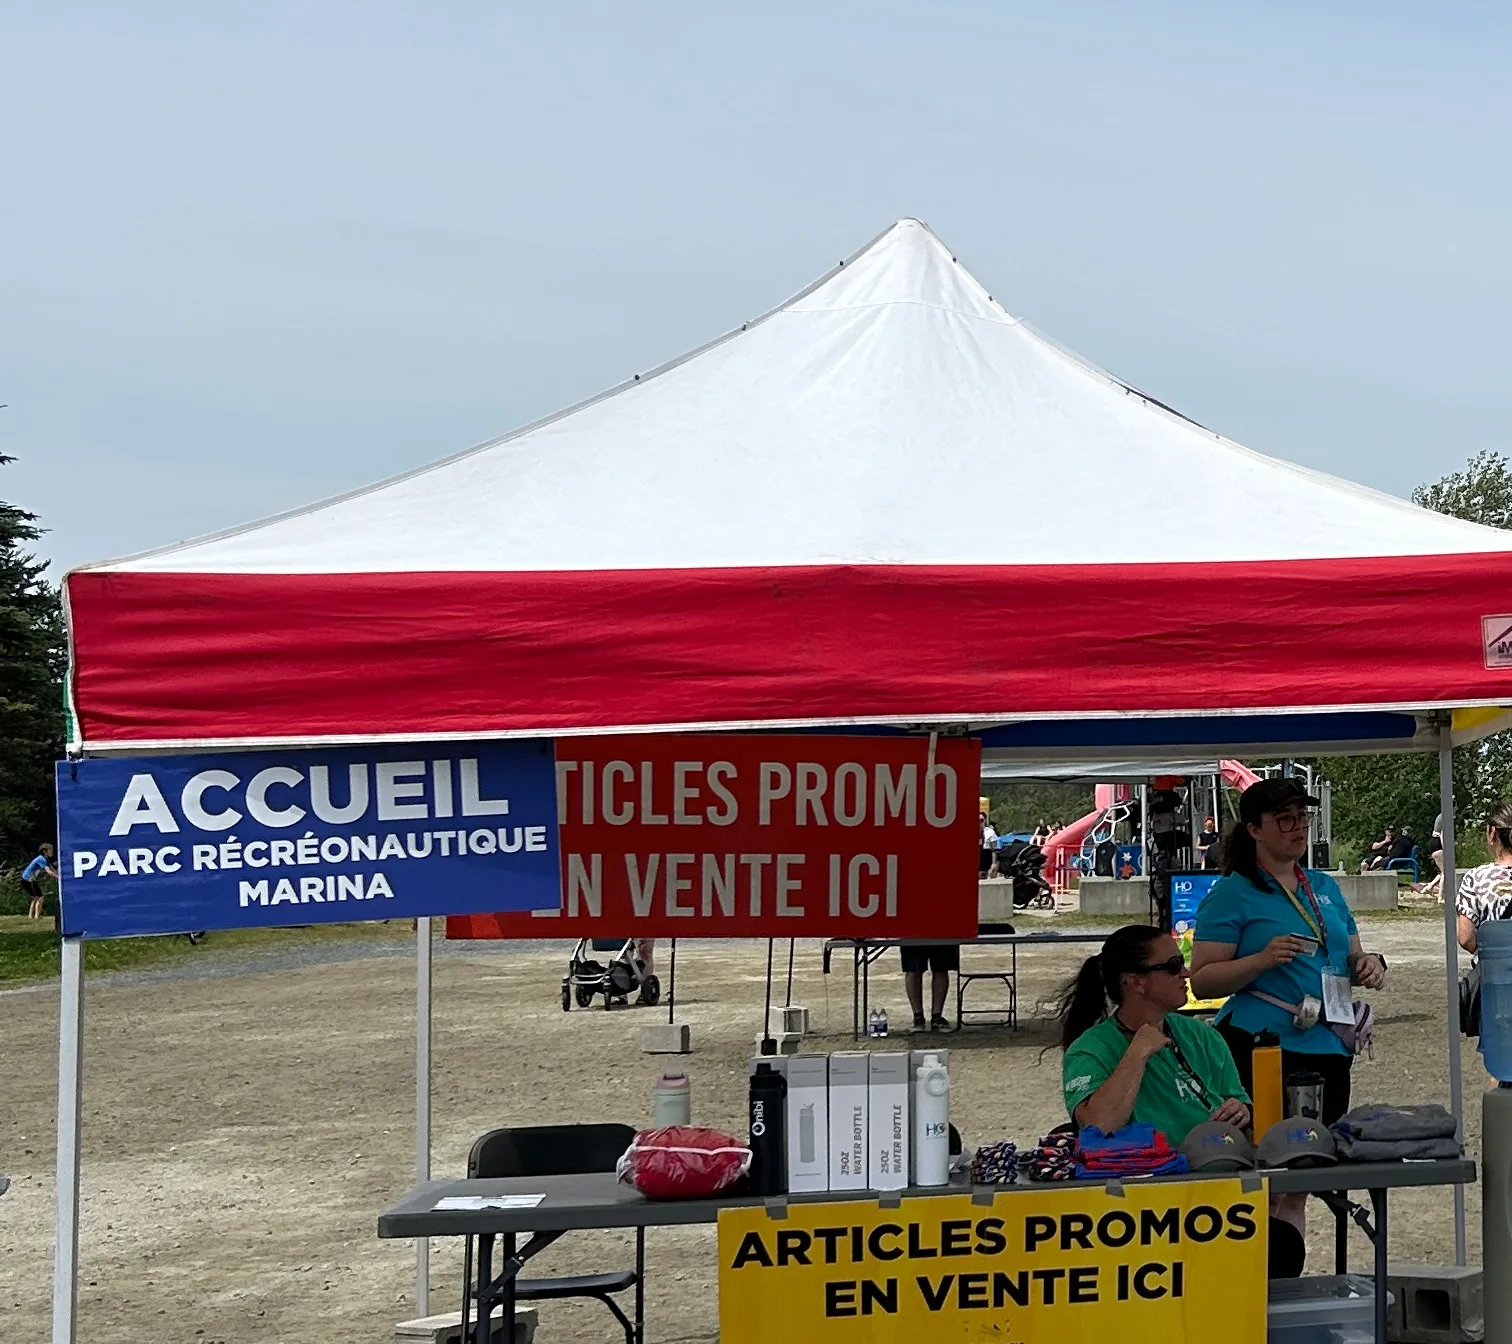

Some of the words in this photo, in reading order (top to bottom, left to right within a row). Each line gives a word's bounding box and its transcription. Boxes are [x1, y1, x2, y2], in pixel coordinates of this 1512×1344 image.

[108, 758, 509, 836] ACCUEIL
[759, 761, 958, 828] PROMO
[73, 846, 182, 878] PARC
[193, 826, 548, 871] RÉCRÉONAUTIQUE
[239, 873, 394, 907] MARINA
[625, 853, 803, 918] VENTE
[828, 853, 898, 917] ICI
[854, 1105, 863, 1141] BOTTLE
[893, 1104, 902, 1139] BOTTLE
[854, 1143, 863, 1175] WATER
[893, 1142, 902, 1174] WATER
[731, 1217, 1008, 1270] ARTICLES
[1024, 1203, 1258, 1253] PROMOS
[825, 1278, 899, 1318] EN
[916, 1266, 1100, 1312] VENTE
[1116, 1262, 1184, 1301] ICI
